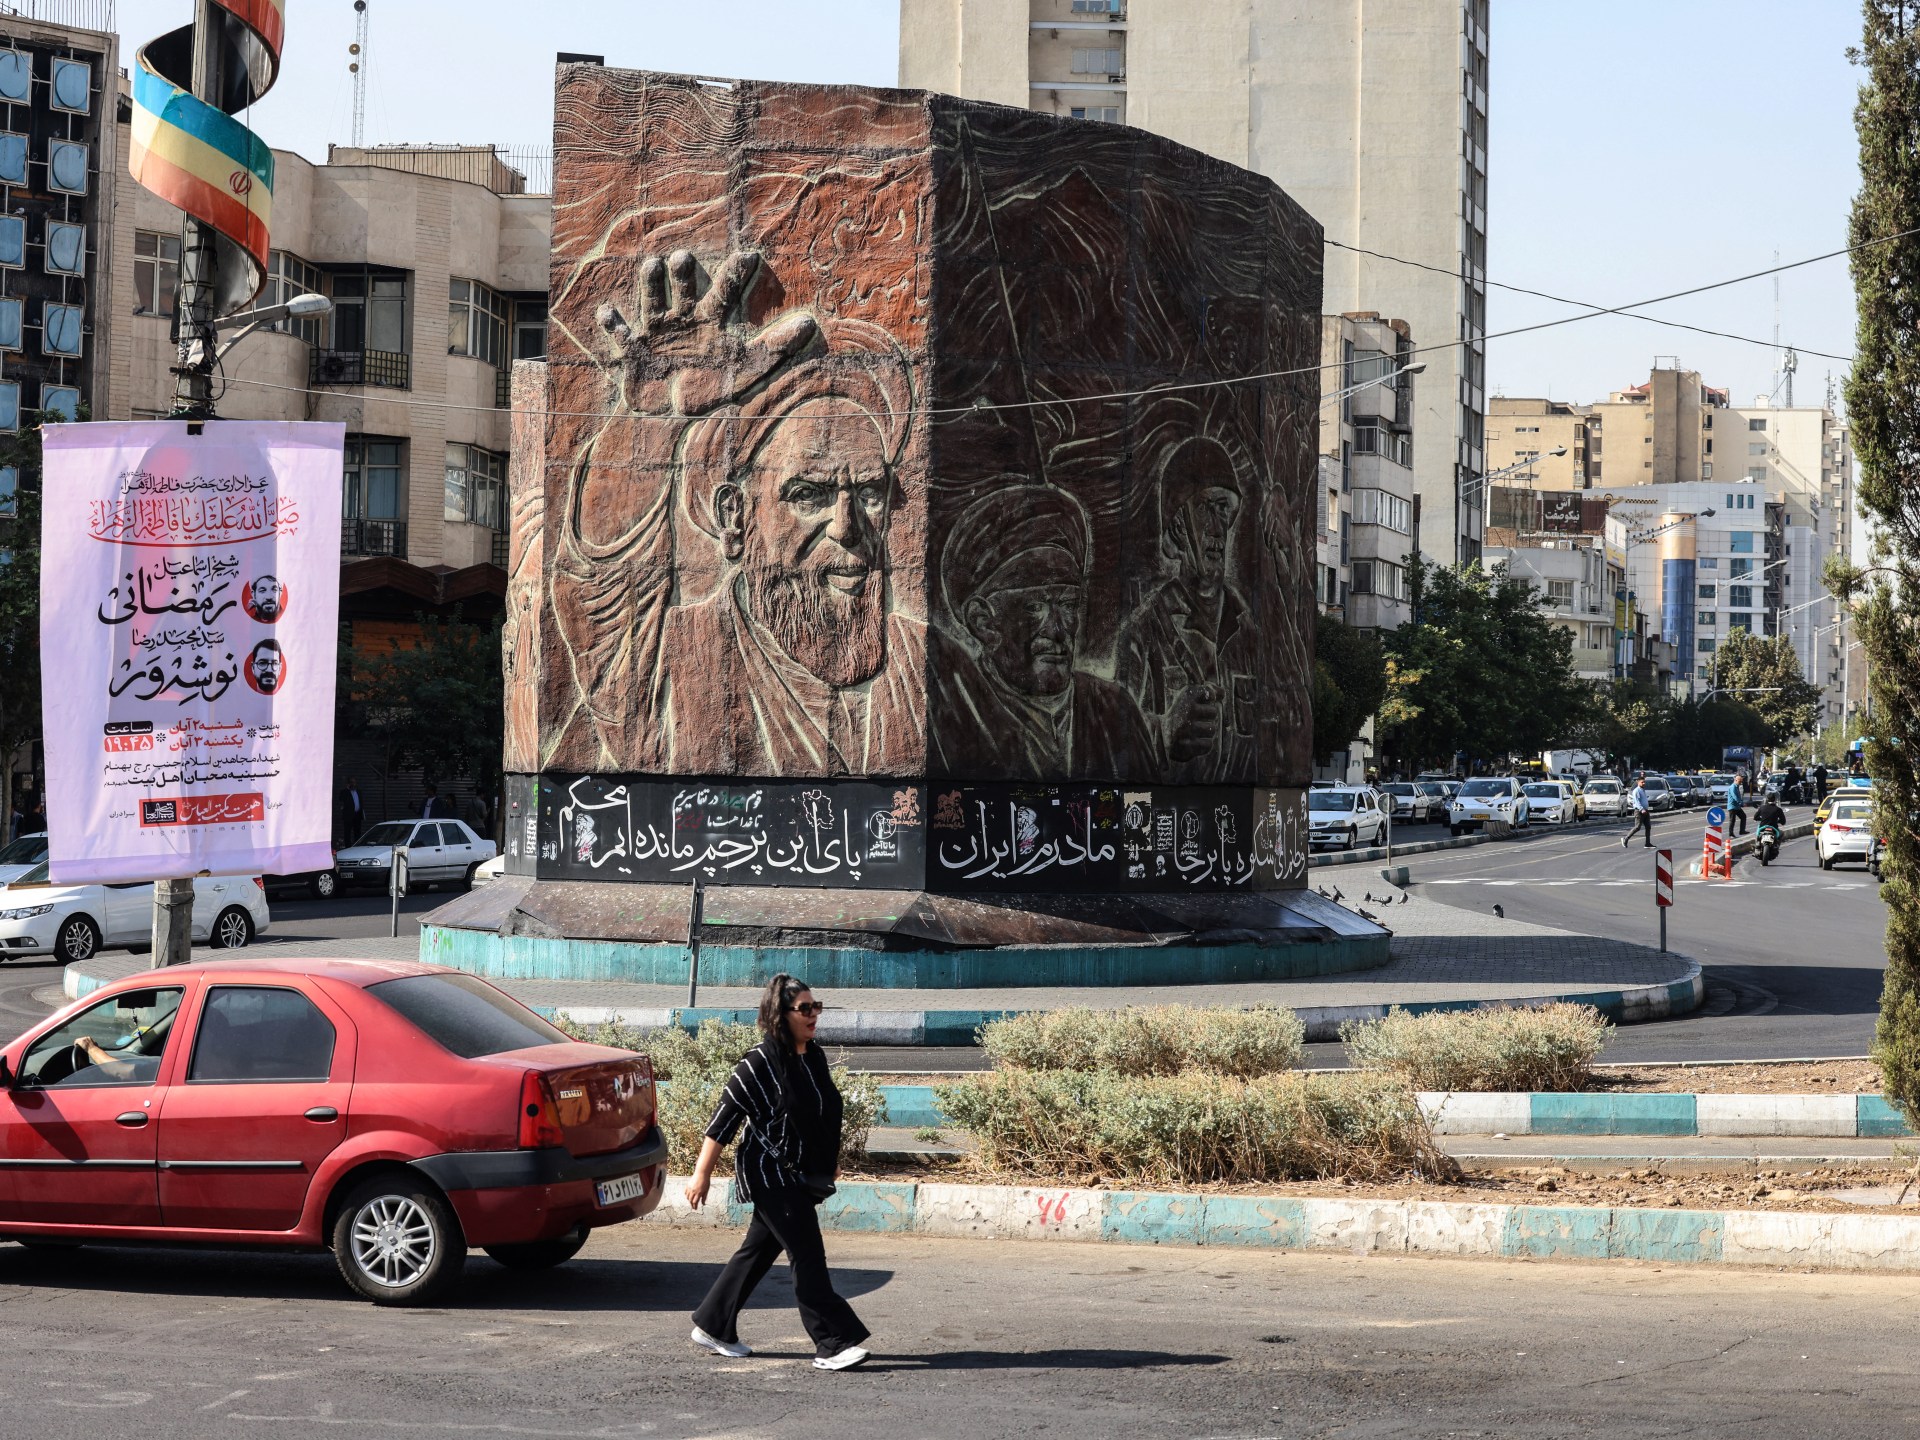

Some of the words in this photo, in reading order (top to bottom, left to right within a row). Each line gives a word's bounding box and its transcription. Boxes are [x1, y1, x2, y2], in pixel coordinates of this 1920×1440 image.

[98, 566, 238, 626] رمضانی
[105, 721, 152, 735] ساعت
[169, 717, 193, 735] آبان
[199, 718, 244, 733] شنبه
[105, 735, 152, 752] ۱۹:۴۵
[169, 735, 193, 751] آبان
[204, 734, 244, 750] یکشنبه
[103, 761, 132, 775] بهنام
[134, 763, 151, 773] برج
[153, 760, 181, 771] جنب
[128, 775, 156, 788] بیت
[156, 771, 184, 788] اهل
[184, 769, 228, 785] محبان
[229, 768, 281, 782] حسینیه
[708, 795, 719, 805] در
[559, 775, 627, 853] محکم
[766, 802, 820, 874] این
[803, 808, 861, 881] پای
[940, 800, 1017, 879] ایران
[1007, 805, 1116, 875] مادرم
[669, 828, 768, 877] پرچم
